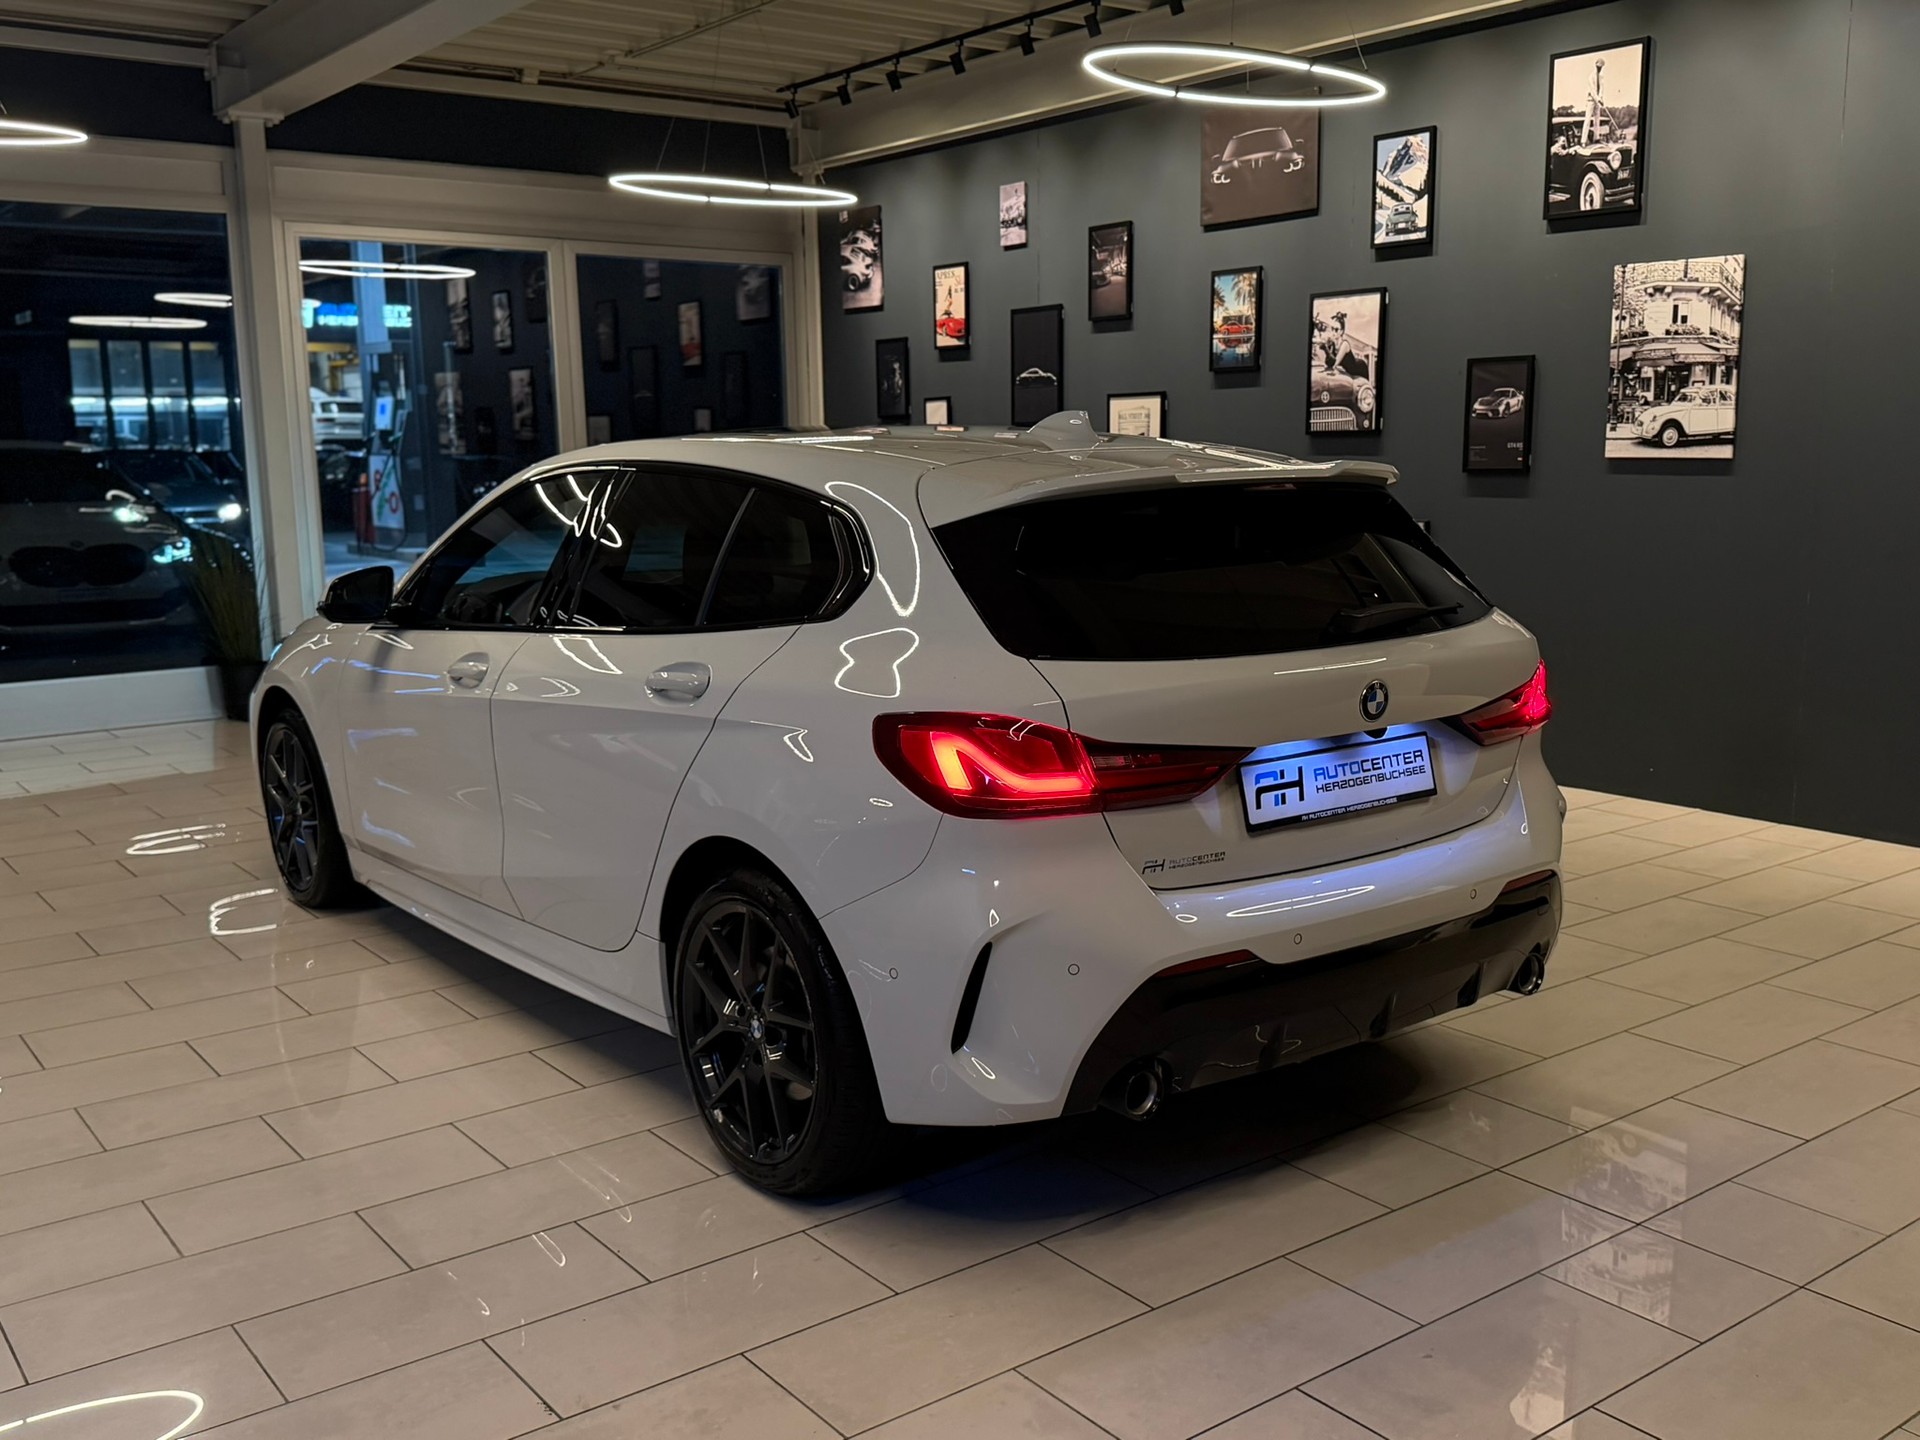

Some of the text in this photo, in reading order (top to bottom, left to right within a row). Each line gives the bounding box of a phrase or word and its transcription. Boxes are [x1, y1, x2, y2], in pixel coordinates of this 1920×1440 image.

[1313, 749, 1424, 782] AUTOCENTER
[1315, 764, 1426, 794] HERZOGENBUCHSEE
[1309, 807, 1346, 820] AUTOCENTER
[1346, 797, 1398, 812] HERZOGENBUCHSEE
[1169, 851, 1226, 865] AUTOCENTER
